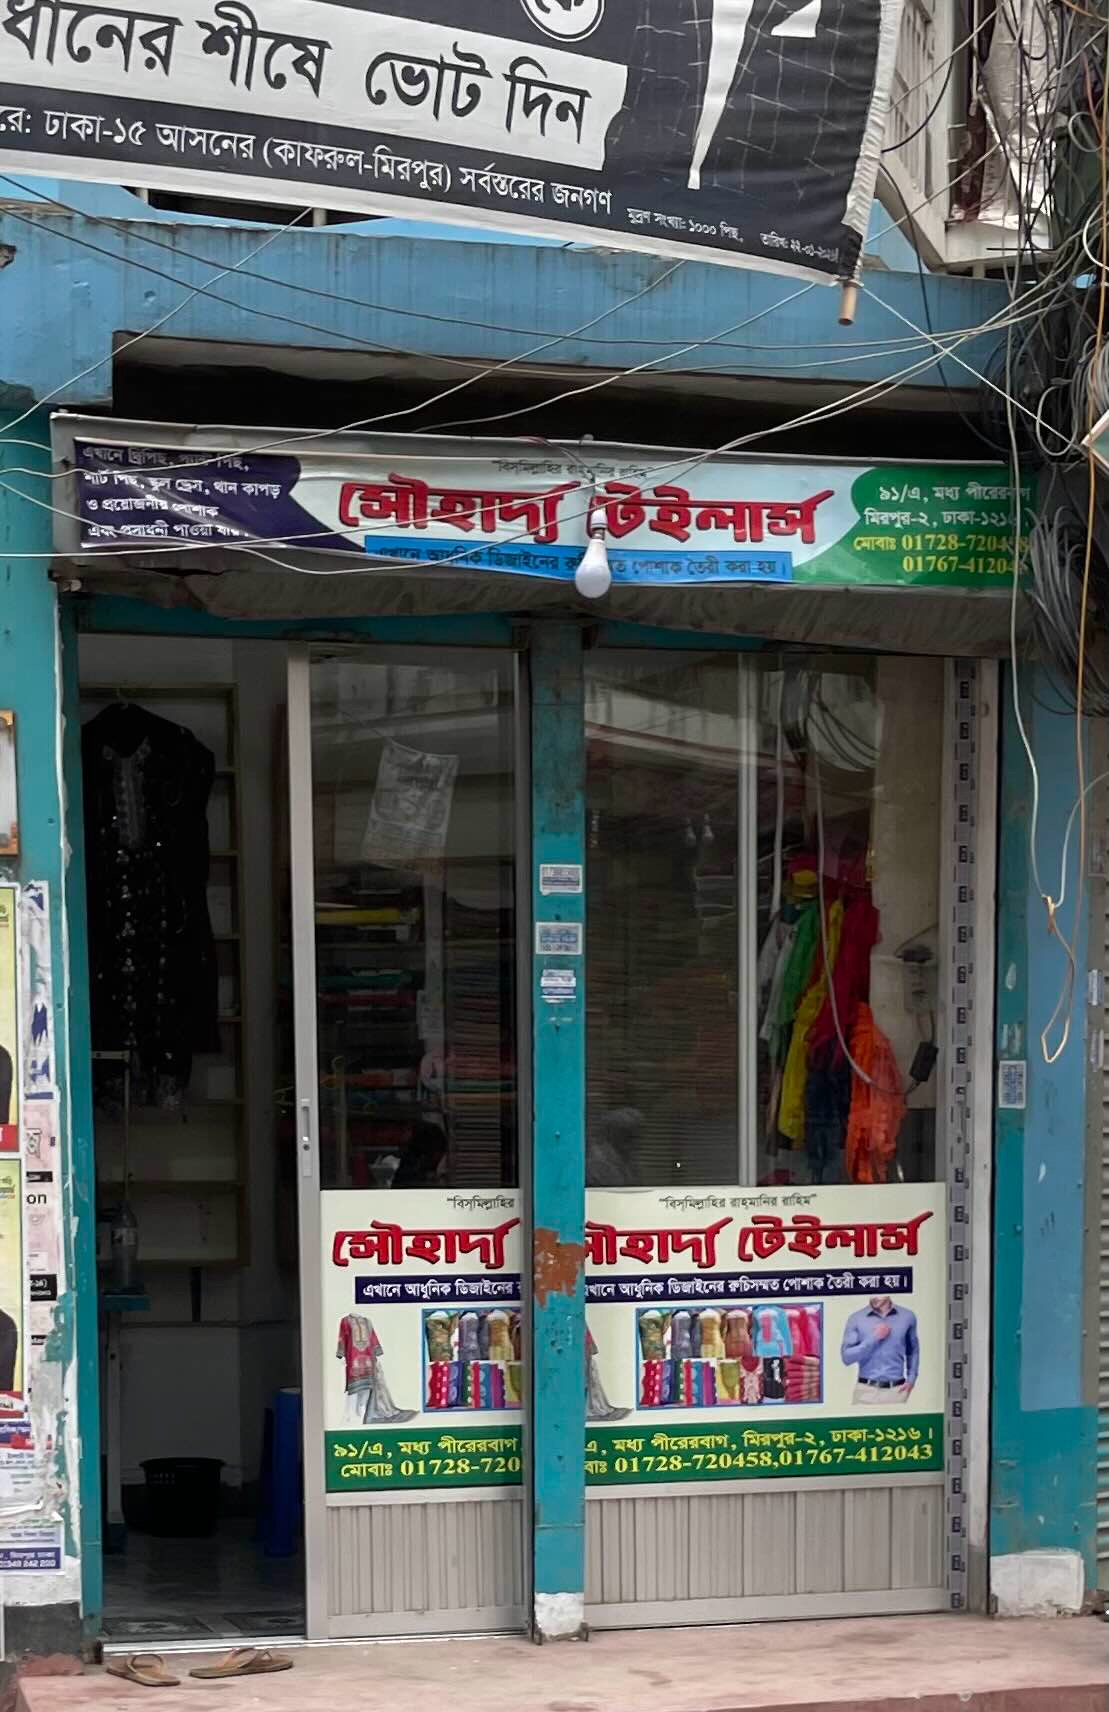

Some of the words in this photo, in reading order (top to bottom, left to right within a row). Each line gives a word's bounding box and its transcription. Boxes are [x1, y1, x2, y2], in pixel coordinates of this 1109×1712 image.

[1, 0, 184, 77] ধানের
[195, 0, 333, 99] শীষে
[364, 40, 494, 121] ভোট
[502, 55, 592, 145] দিন
[43, 109, 147, 146] ঢাকা-১৫
[154, 123, 257, 160] আসনের
[262, 136, 452, 193] (কাফরুল-মিরপুর)
[457, 162, 546, 204] সর্বস্তরের
[550, 181, 613, 215] জনগণ
[688, 218, 717, 236] ১০০০
[212, 480, 238, 496] থান
[241, 483, 282, 500] কাপড়
[931, 486, 960, 501] মধ্য
[86, 498, 99, 511] ও
[338, 472, 582, 544] সৌহার্দ্য
[332, 1216, 521, 1270] সৌহার্দ্য
[737, 1210, 934, 1262] টেইলার্স
[362, 1284, 401, 1298] এখানে
[404, 1279, 452, 1300] আধুনিক
[454, 1278, 514, 1297] ডিজাইনের
[618, 1278, 665, 1299] আধুনিক
[667, 1276, 725, 1296] ডিজাইনের
[782, 1274, 825, 1293] পোশাক
[826, 1272, 855, 1290] তৈরী
[858, 1275, 880, 1289] করা
[398, 1440, 432, 1456] মধ্য
[437, 1434, 520, 1455] পীরেরবাগ
[612, 1438, 646, 1453] মধ্য
